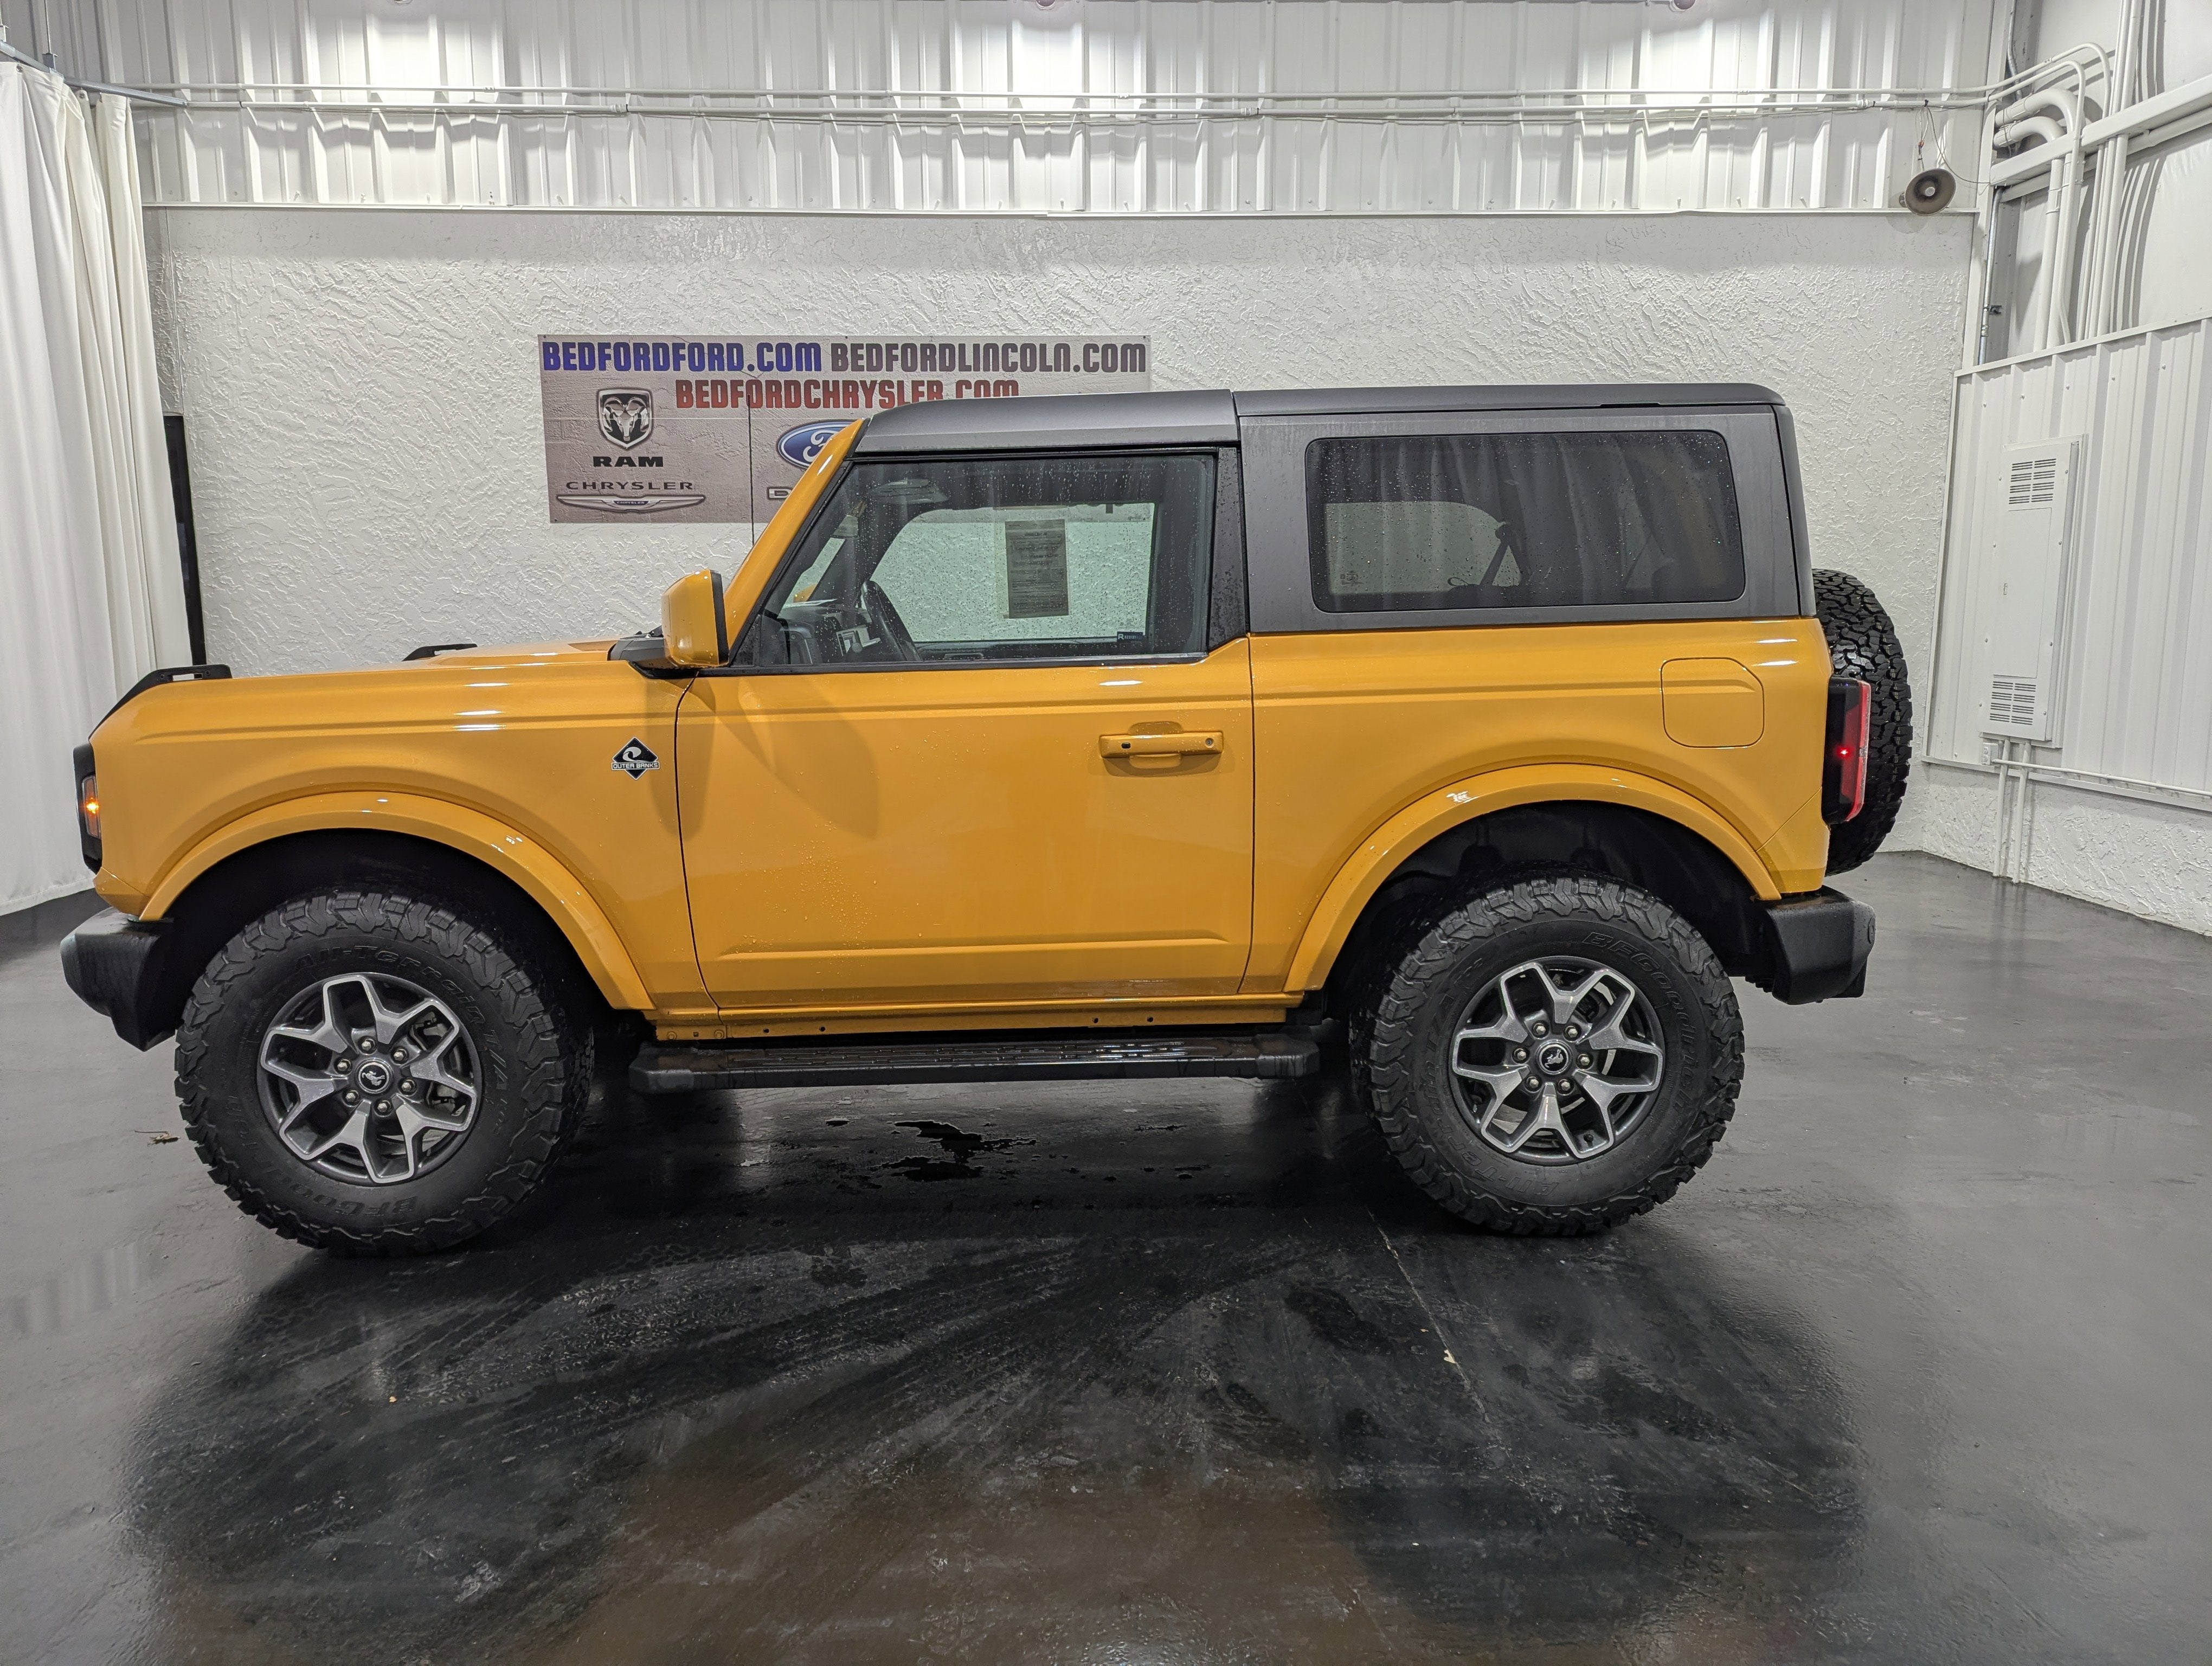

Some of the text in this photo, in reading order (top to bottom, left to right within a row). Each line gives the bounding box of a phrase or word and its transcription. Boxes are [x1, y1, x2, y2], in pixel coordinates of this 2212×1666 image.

[542, 341, 1146, 373] BEDFORDFORD.COM BEDFORDLINCOLN.COM
[676, 379, 1019, 409] BEDFORDCHRYSLERCOM
[593, 456, 664, 467] RAM
[565, 481, 693, 490] CHRYSLER
